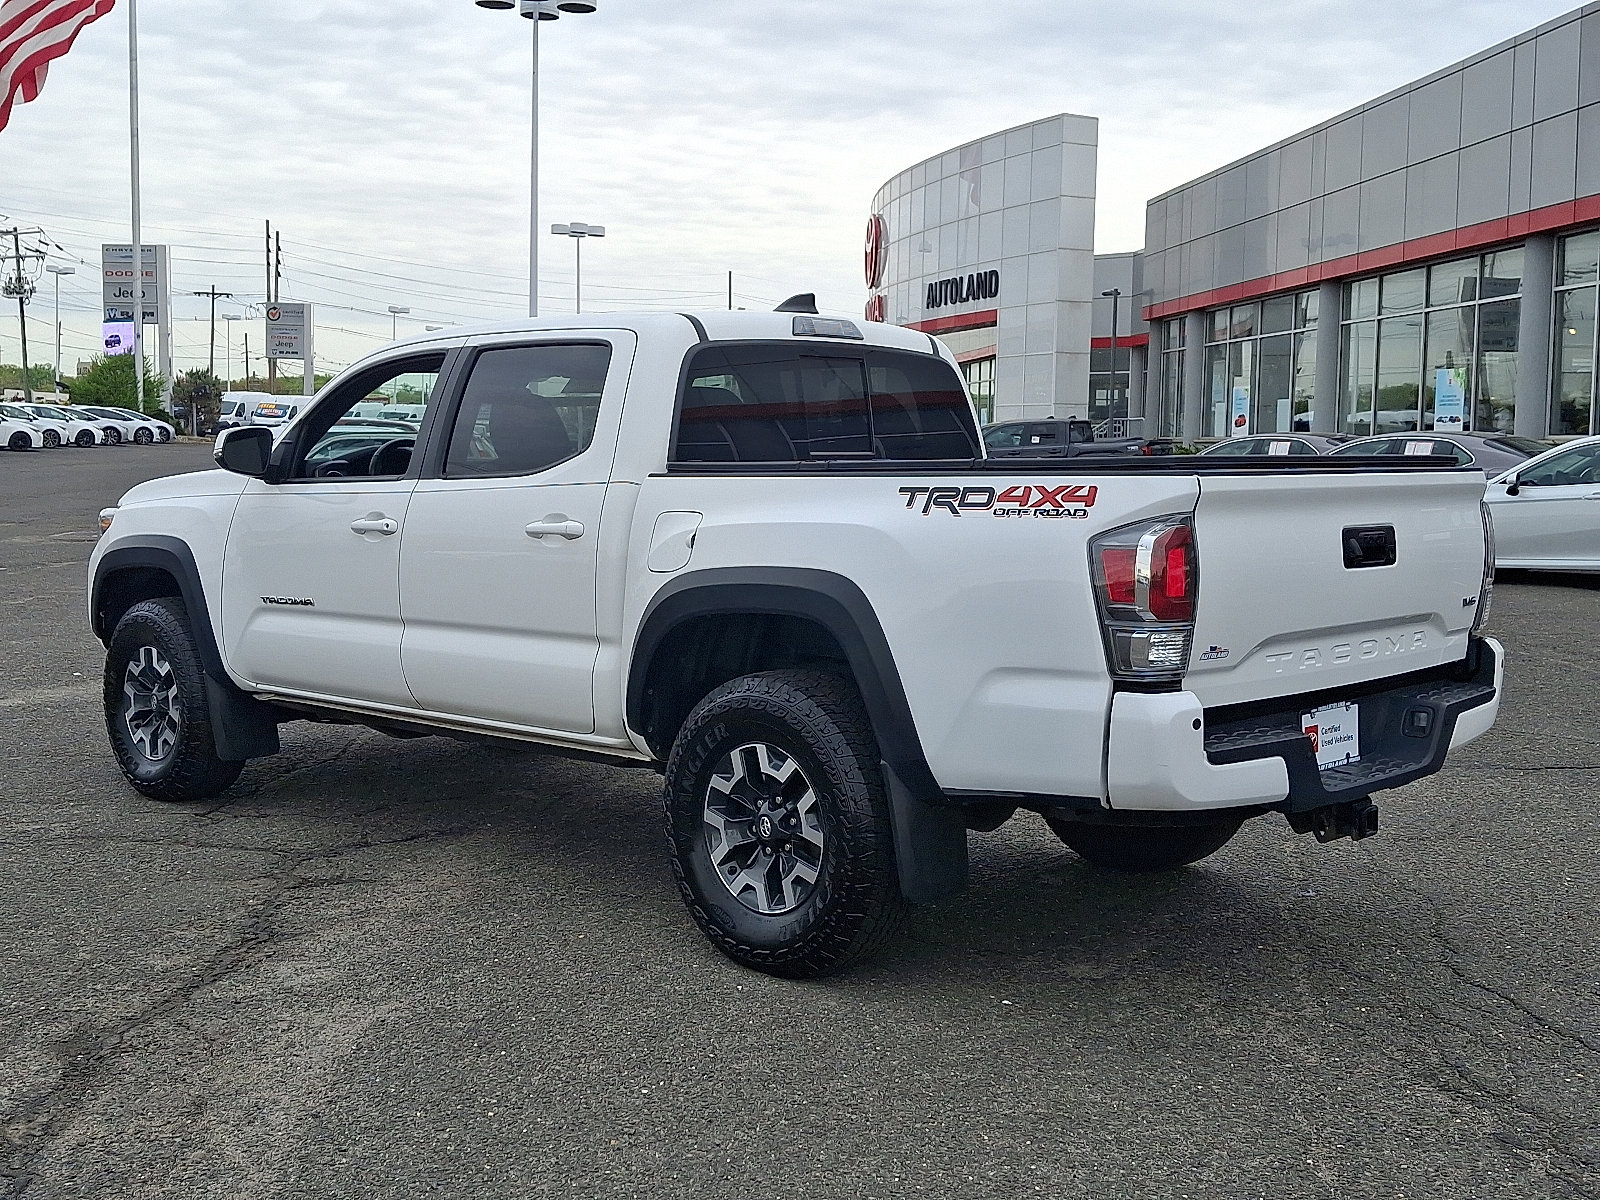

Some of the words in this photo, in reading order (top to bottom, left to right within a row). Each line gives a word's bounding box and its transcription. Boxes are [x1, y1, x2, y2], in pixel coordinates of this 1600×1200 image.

[926, 270, 999, 309] AUTOLAND
[898, 486, 997, 517] TRD
[993, 508, 1032, 518] OFF
[1032, 508, 1090, 519] ROAD
[260, 596, 315, 606] TACOMA
[1265, 630, 1427, 673] TACOMA
[1321, 724, 1341, 735] Certified
[1322, 738, 1333, 747] Used
[1334, 735, 1353, 744] Vehicles
